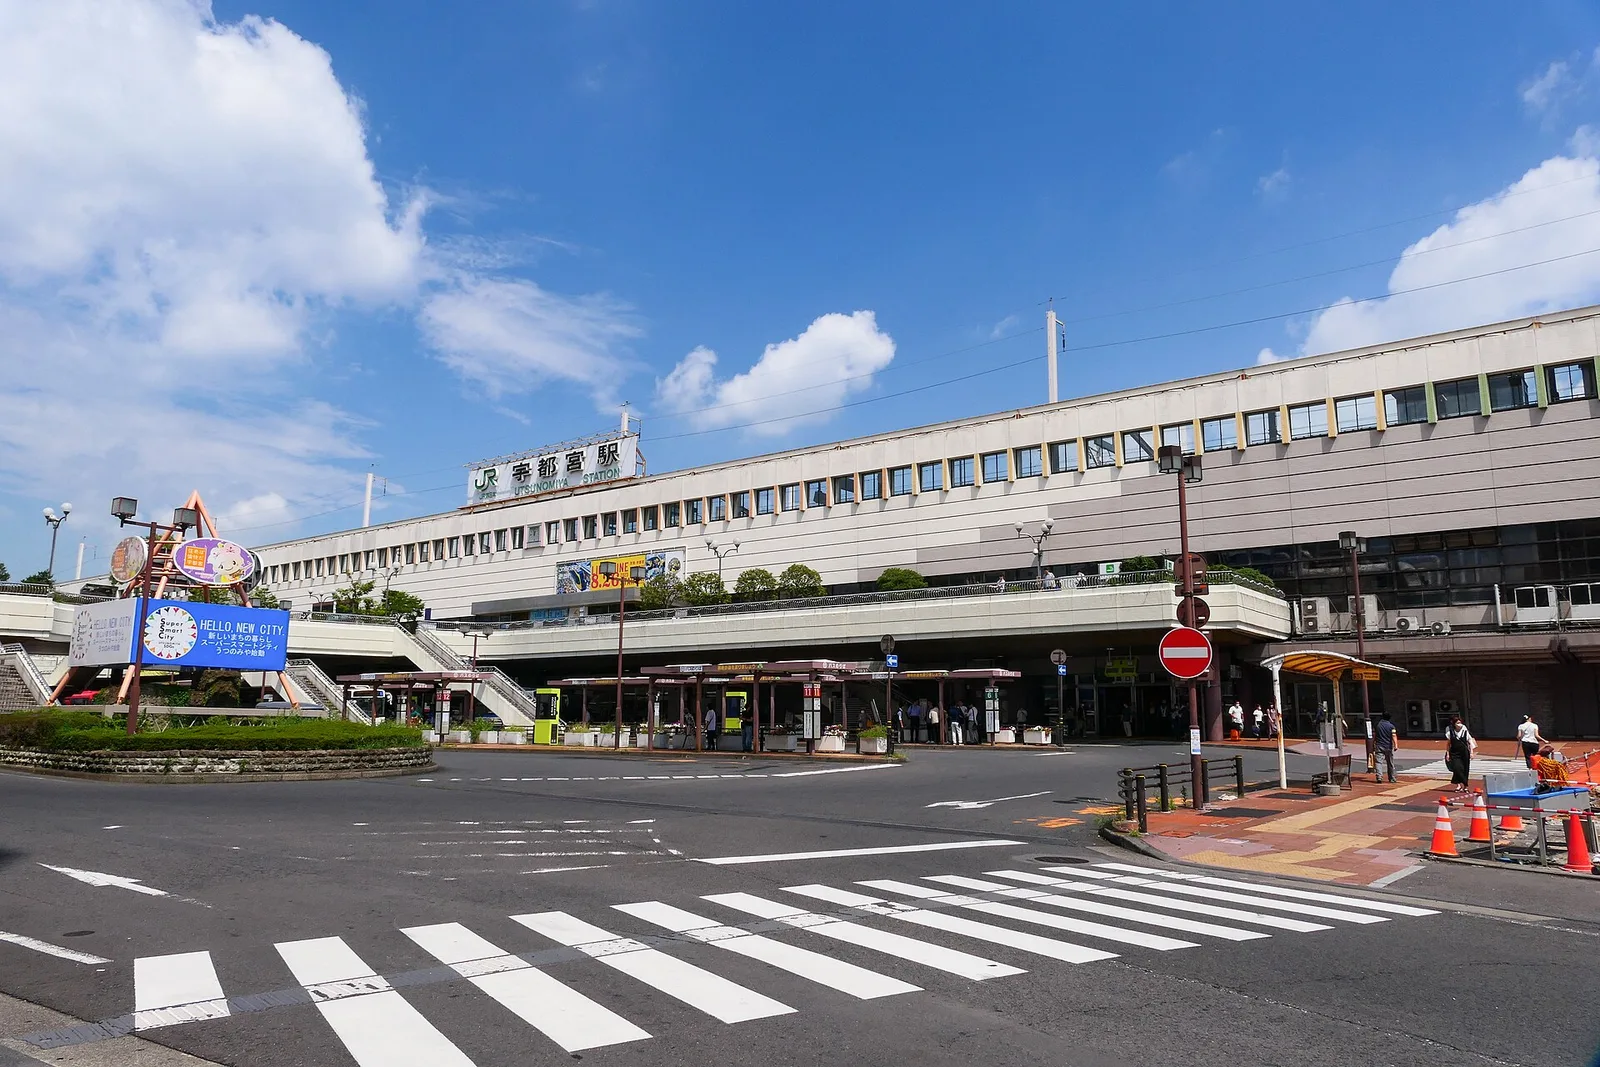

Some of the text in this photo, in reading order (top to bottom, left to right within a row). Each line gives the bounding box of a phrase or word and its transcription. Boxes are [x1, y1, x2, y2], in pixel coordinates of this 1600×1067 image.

[512, 442, 620, 481] 宇都宮駅
[474, 468, 497, 490] JR
[514, 467, 620, 496] UTSUNOMIYA STATION
[160, 618, 183, 627] Super
[200, 619, 285, 636] HELLO, NEW CITY.
[159, 624, 183, 633] Smart
[158, 632, 175, 641] City
[208, 632, 272, 643] 新しいまちの暮らし
[200, 639, 279, 651] スーパースマートシティ
[216, 647, 266, 657] うつのみや始動
